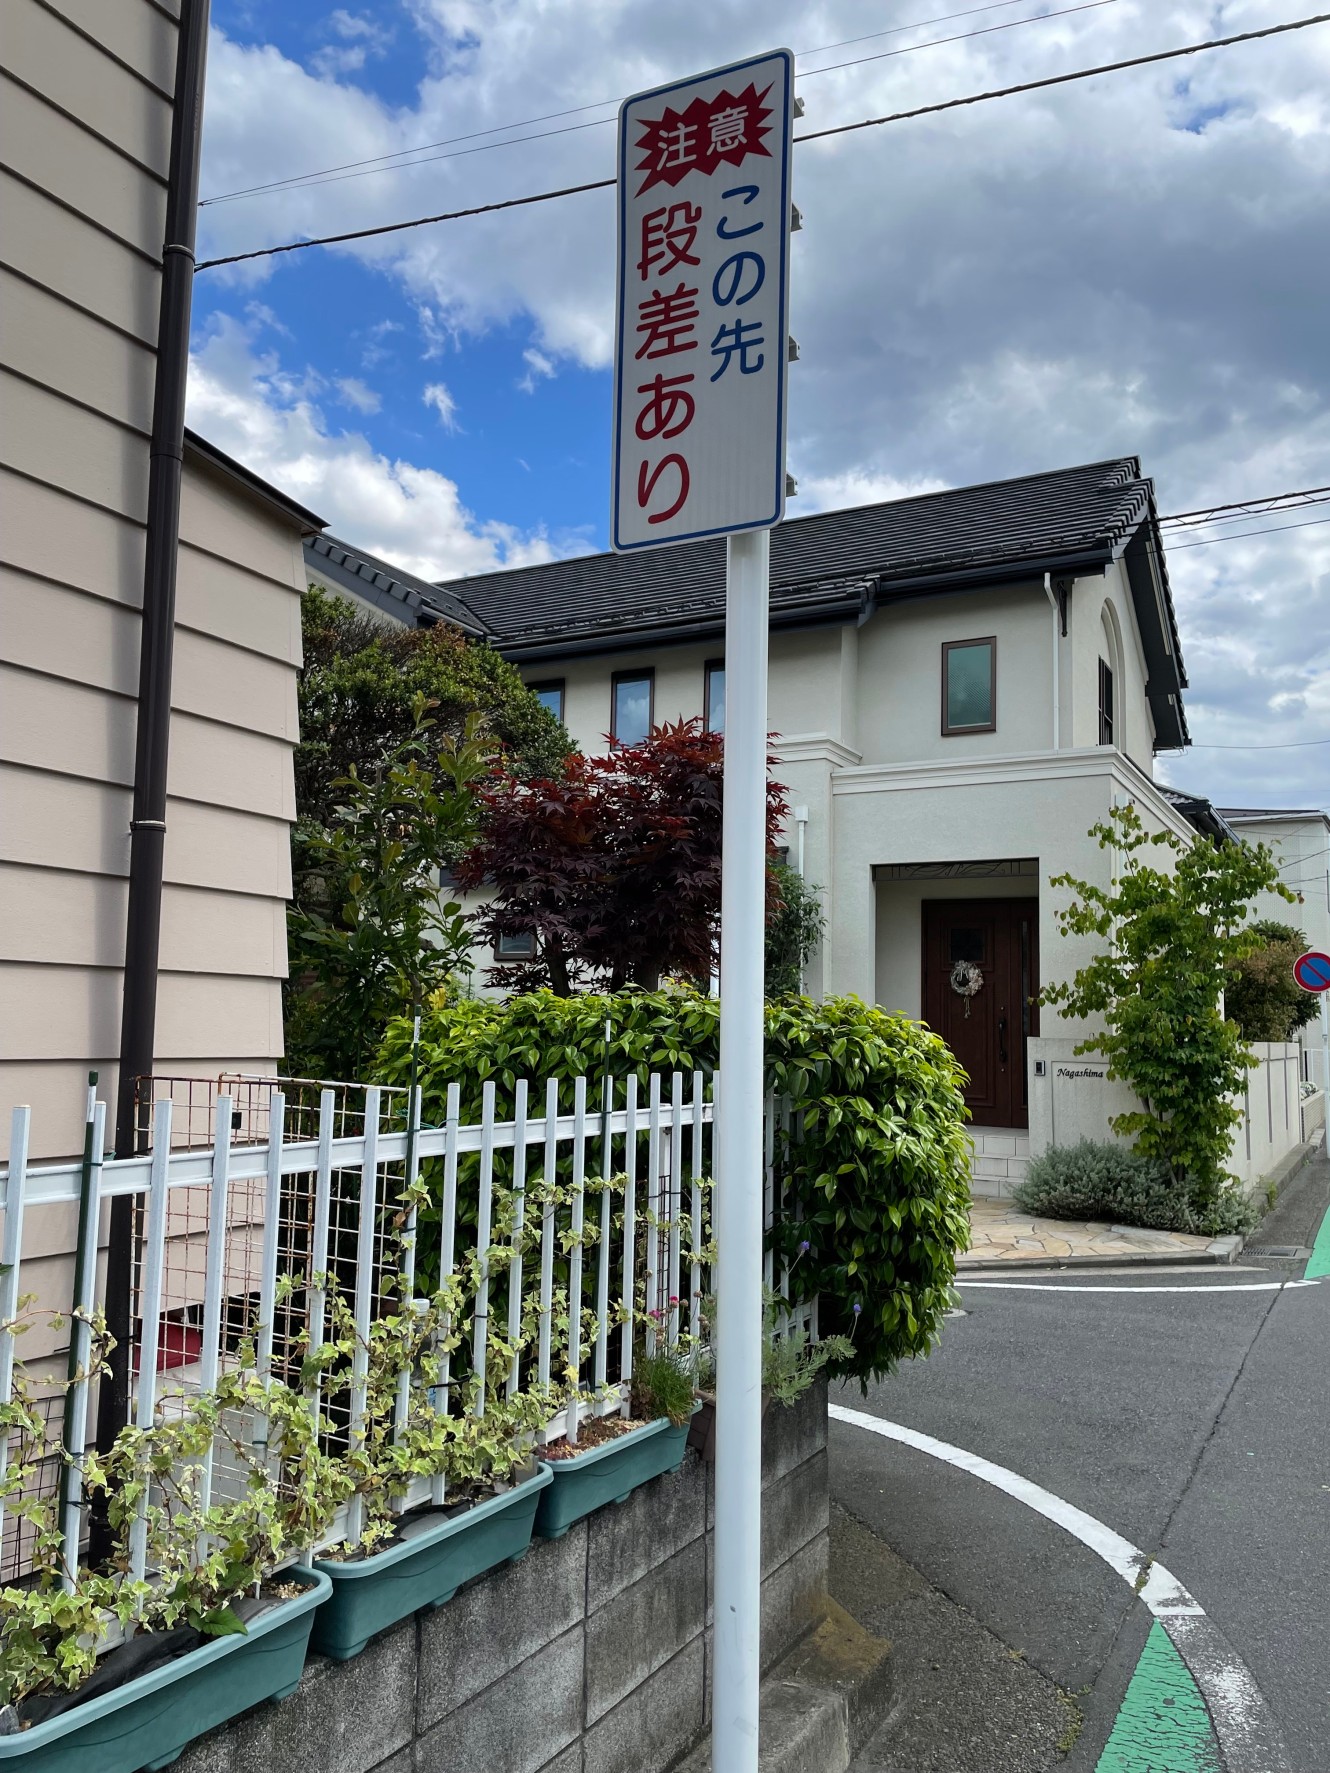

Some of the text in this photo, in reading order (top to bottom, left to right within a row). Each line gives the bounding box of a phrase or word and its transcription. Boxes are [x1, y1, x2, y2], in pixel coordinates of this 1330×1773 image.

[657, 106, 749, 169] 注意
[710, 185, 765, 382] この先
[635, 201, 702, 525] 段差あり
[1057, 1068, 1104, 1079] Nagashima
